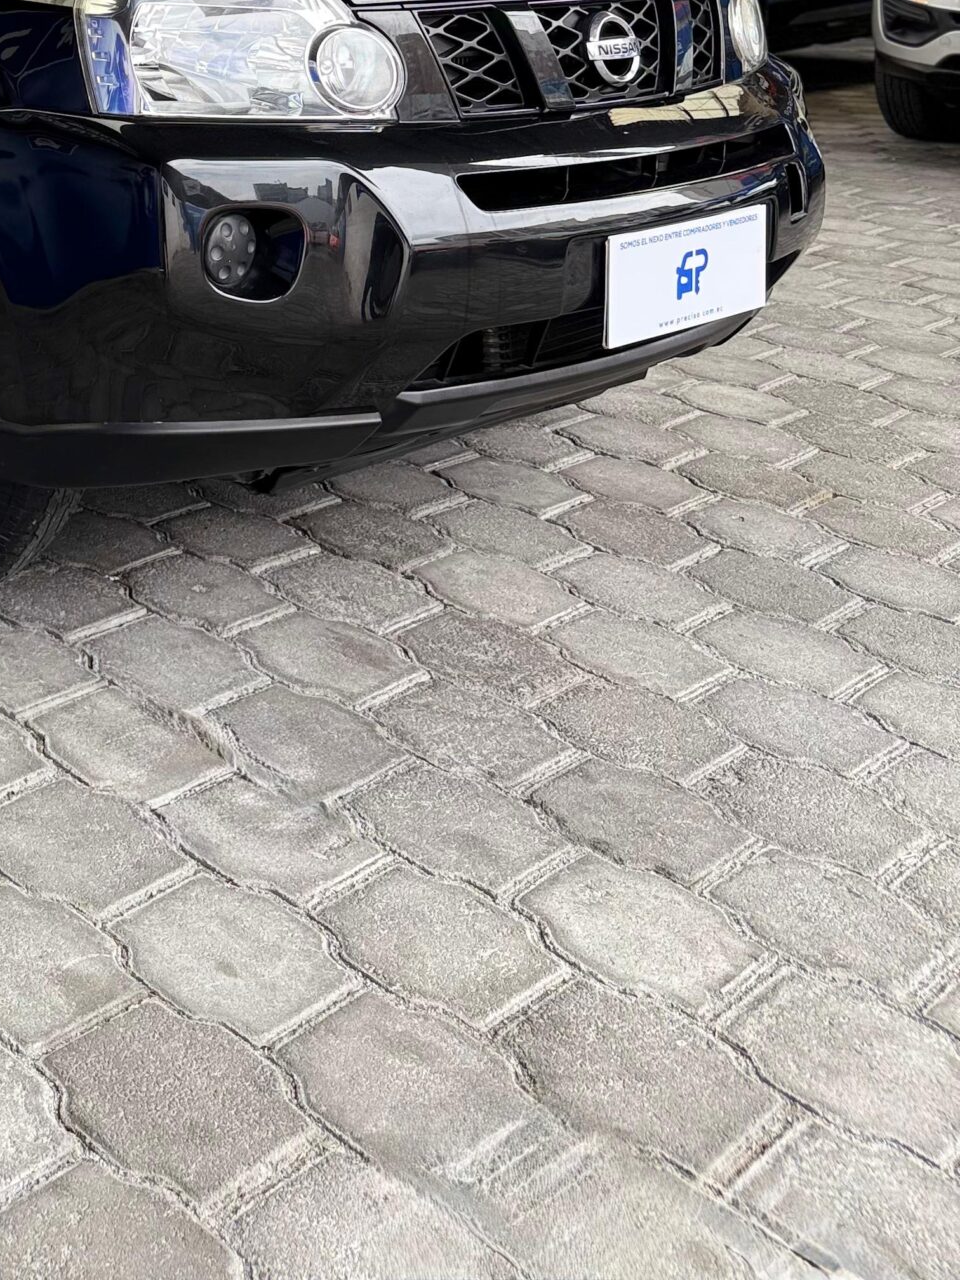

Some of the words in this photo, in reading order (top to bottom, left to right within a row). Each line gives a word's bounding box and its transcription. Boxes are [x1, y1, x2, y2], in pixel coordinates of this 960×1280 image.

[598, 40, 640, 56] NISSAN
[620, 239, 640, 250] SOMOS
[641, 238, 648, 246] EL
[664, 231, 682, 241] ENTRE
[683, 222, 722, 236] COMPRADORES
